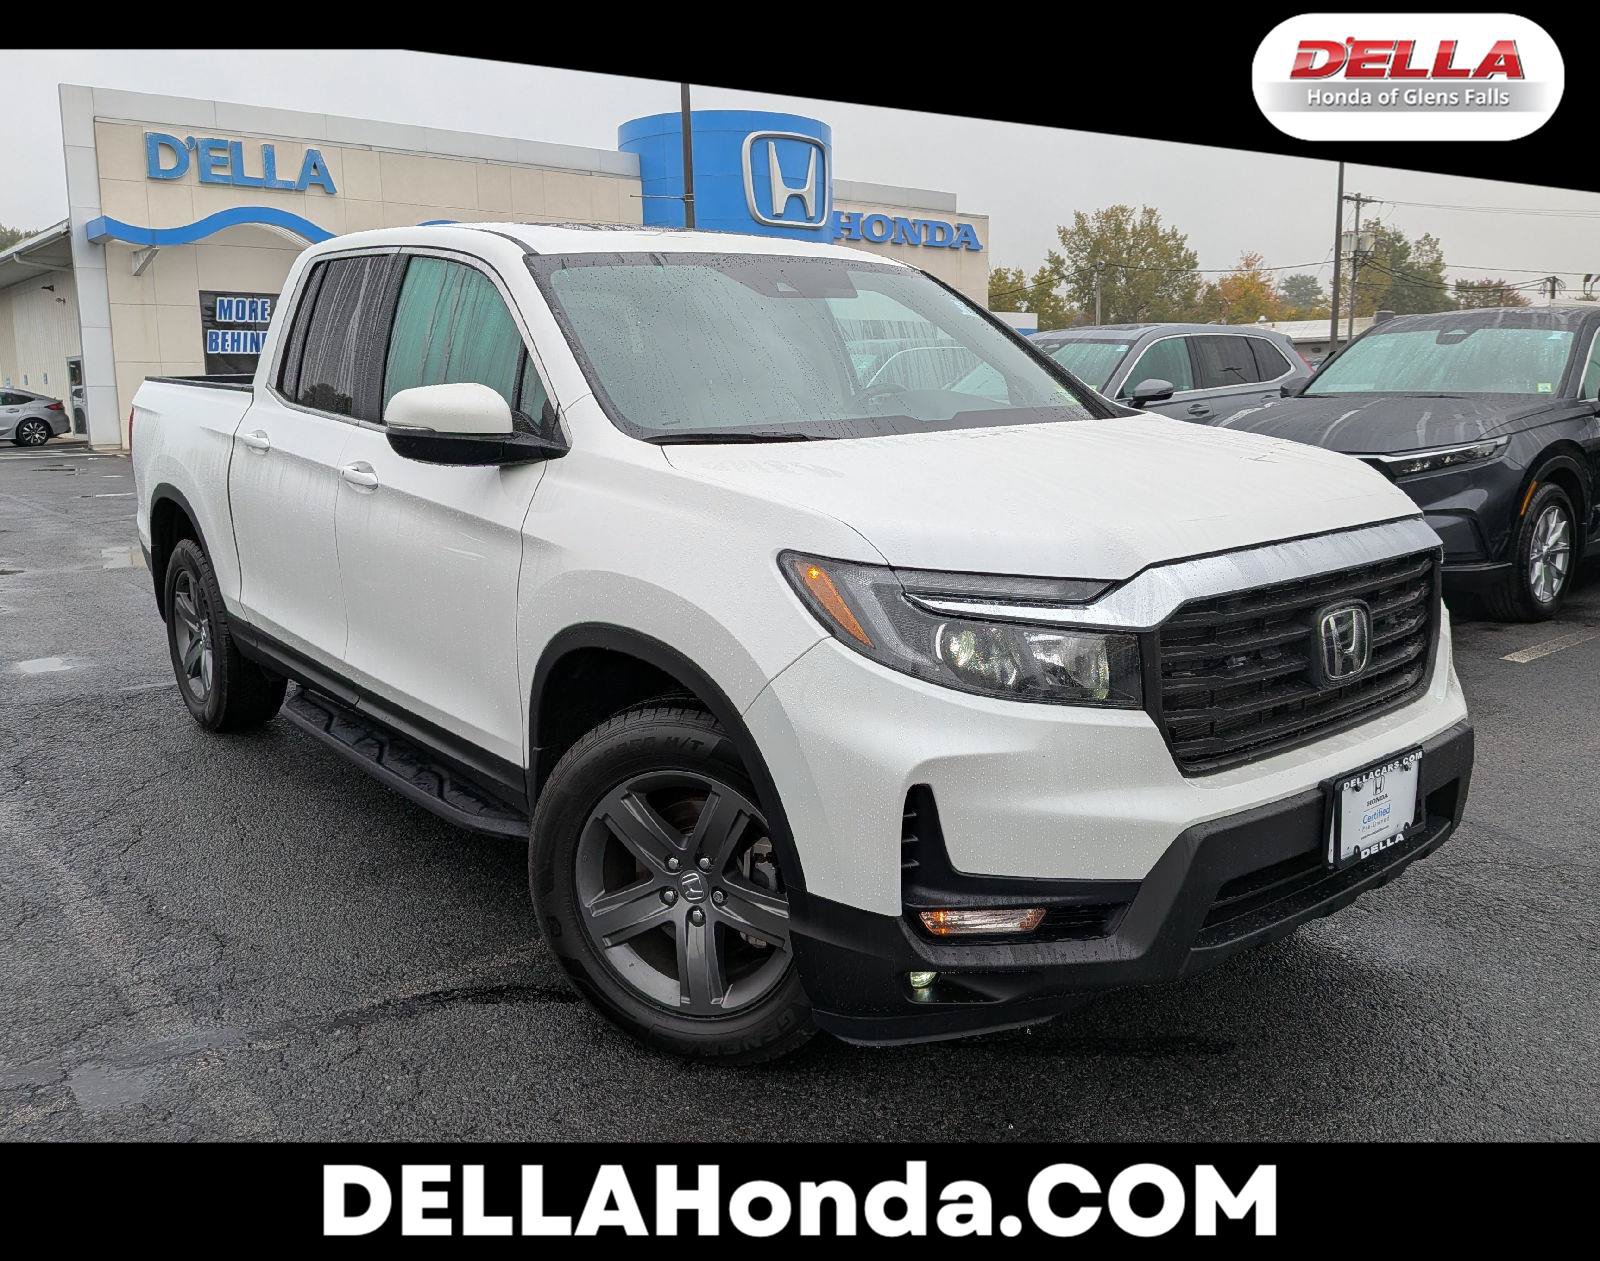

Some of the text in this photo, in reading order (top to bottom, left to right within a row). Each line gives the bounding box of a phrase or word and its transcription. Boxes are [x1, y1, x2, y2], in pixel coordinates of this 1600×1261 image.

[144, 131, 337, 195] D'ELLA
[833, 210, 983, 251] HONDA
[216, 297, 271, 323] MORE
[1343, 750, 1423, 791] DELLACARS.COM
[1362, 804, 1391, 825] Certified
[1360, 833, 1405, 860] DELLA
